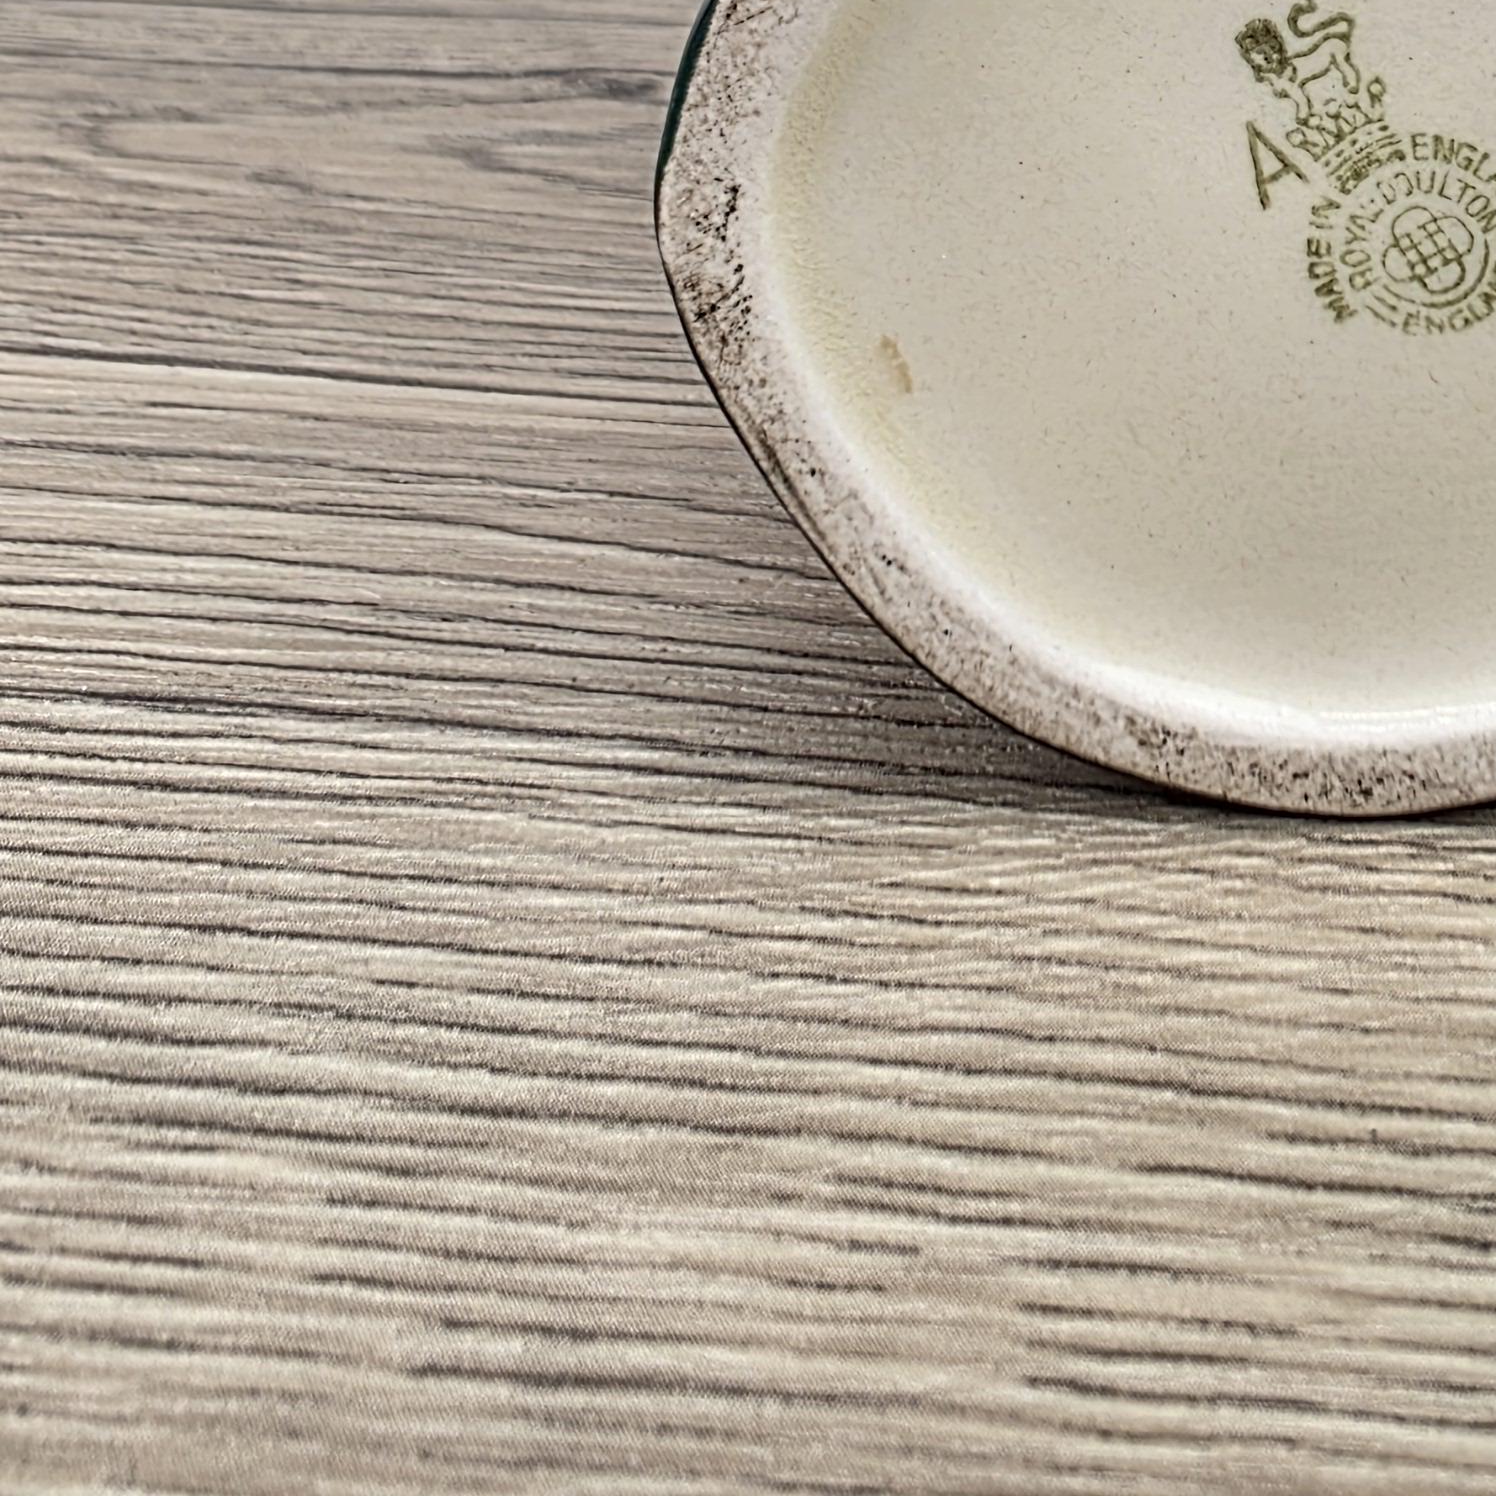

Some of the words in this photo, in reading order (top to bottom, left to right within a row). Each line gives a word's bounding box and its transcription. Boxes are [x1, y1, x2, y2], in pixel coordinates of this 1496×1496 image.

[1246, 120, 1310, 211] A
[1308, 196, 1341, 230] IN
[1340, 205, 1384, 292] ROYAL
[1306, 237, 1358, 324] MADE
